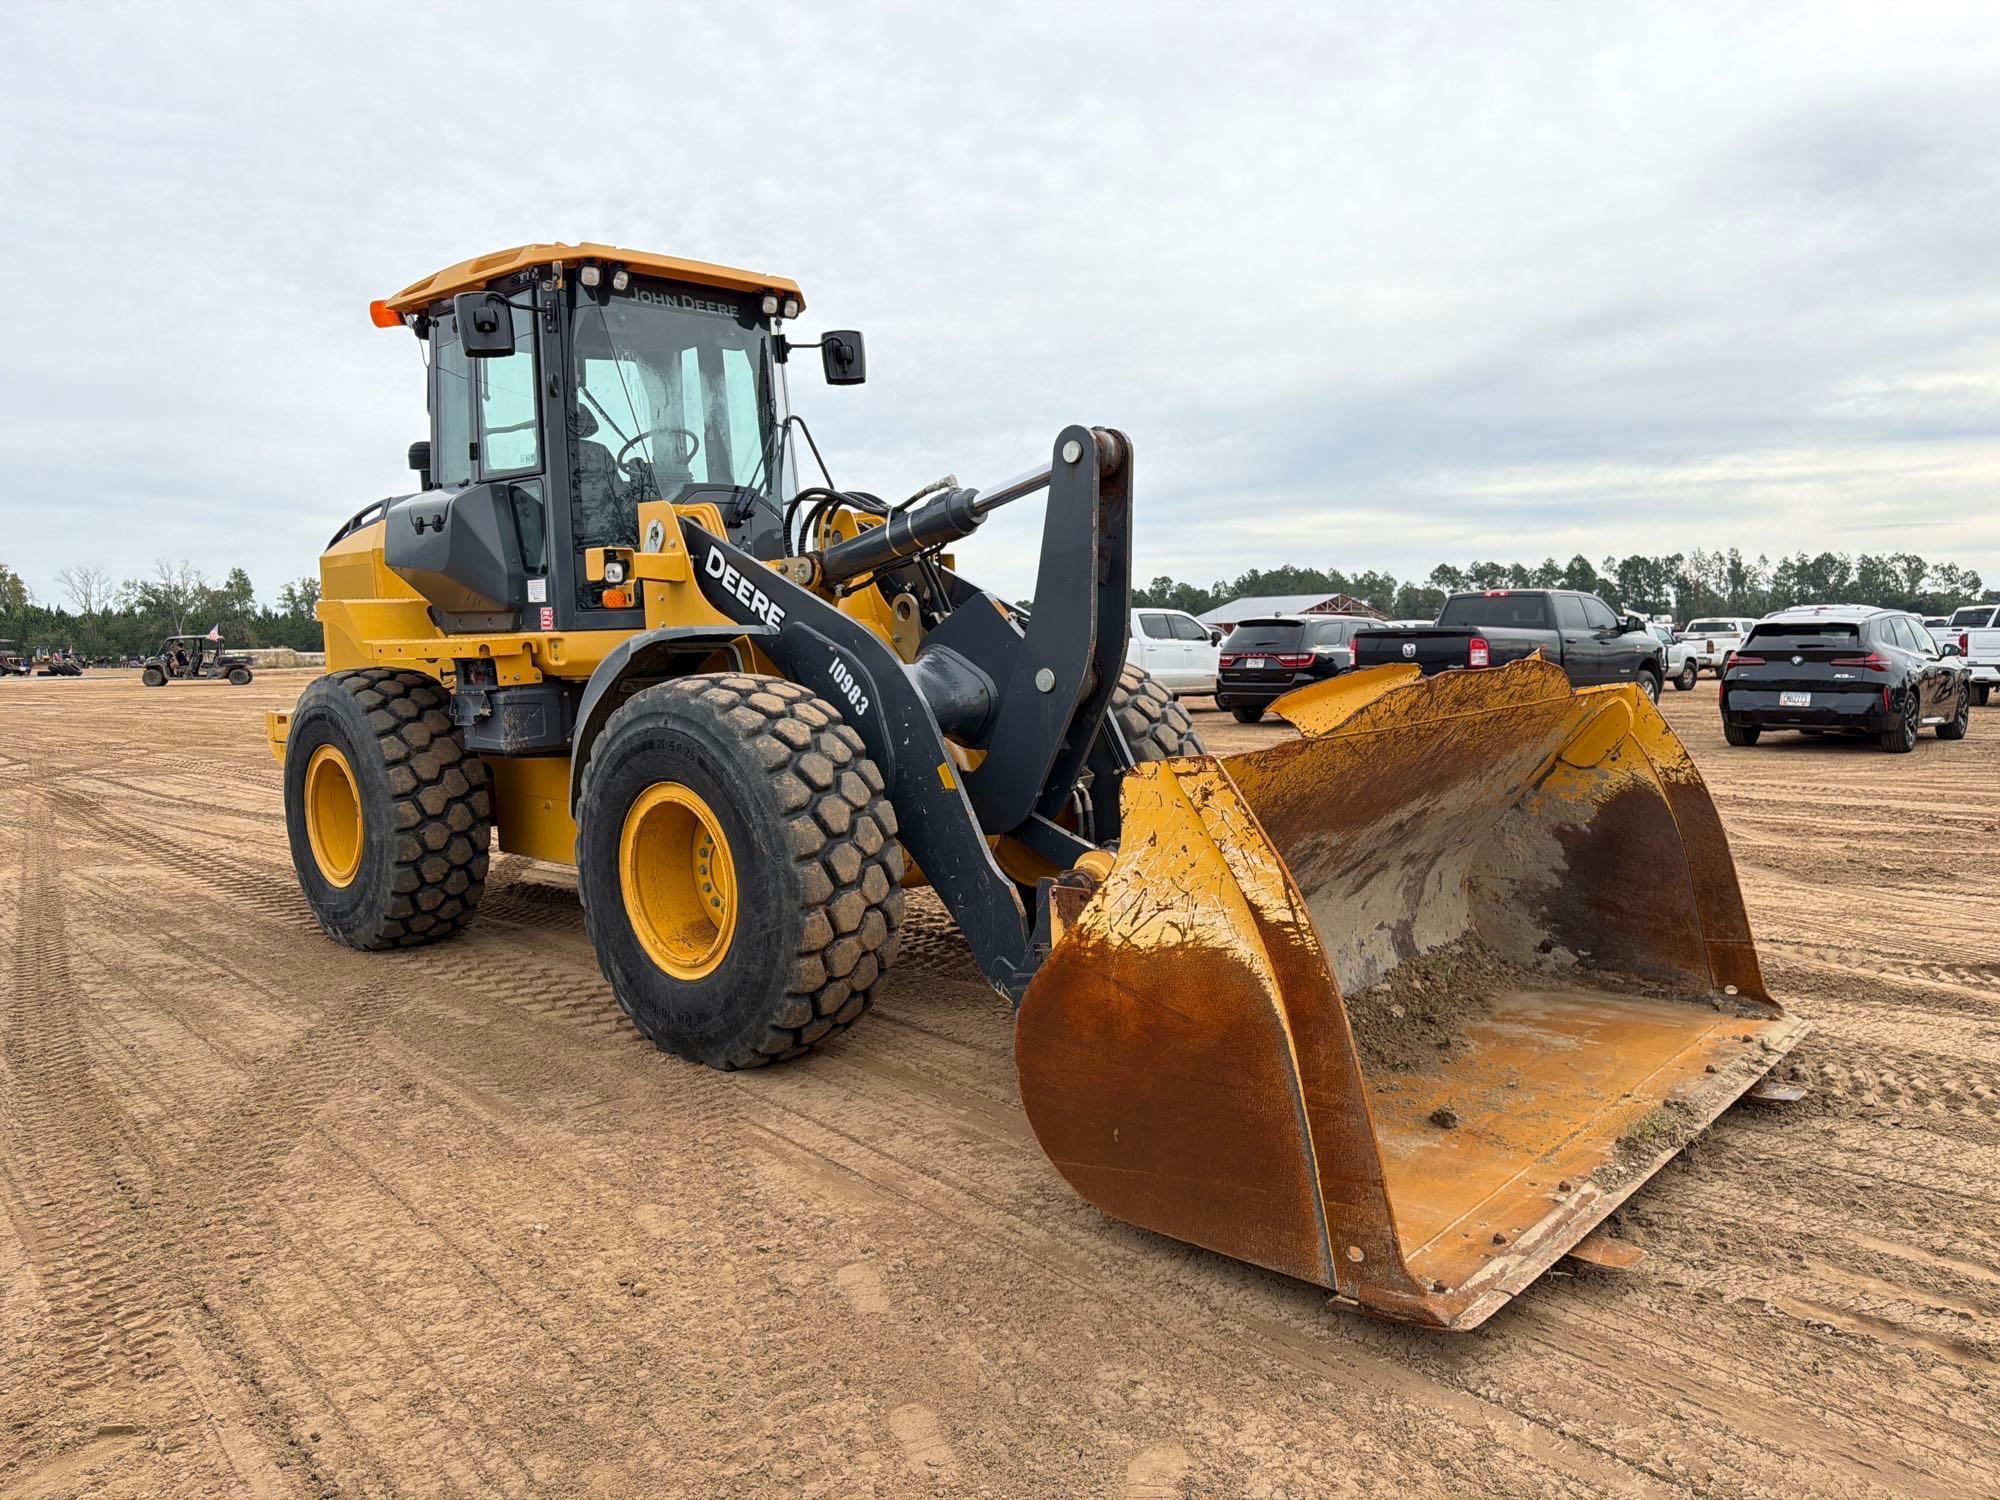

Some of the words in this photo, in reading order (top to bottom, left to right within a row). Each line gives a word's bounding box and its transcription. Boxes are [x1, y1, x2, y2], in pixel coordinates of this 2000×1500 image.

[629, 287, 679, 308] JOHN
[681, 295, 740, 318] DEERE
[705, 545, 786, 632] DEERE
[828, 656, 869, 716] 10983
